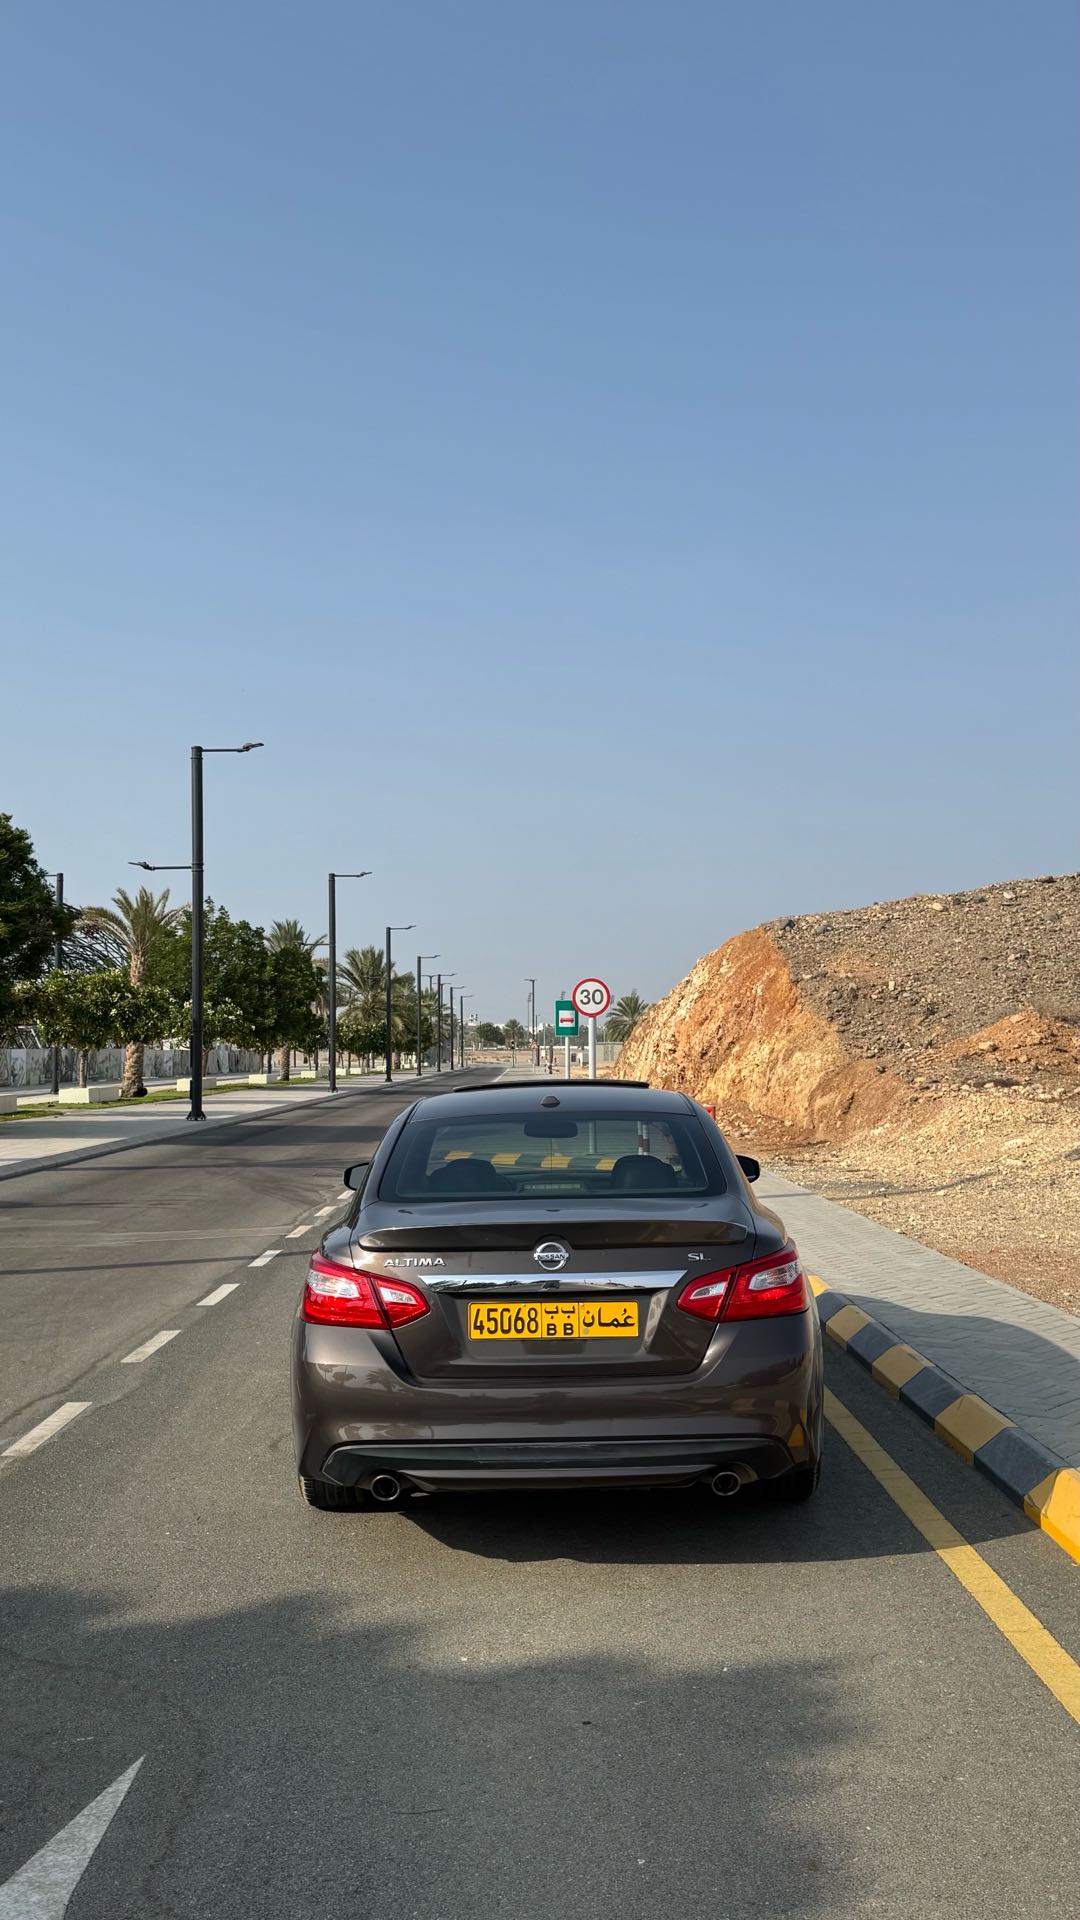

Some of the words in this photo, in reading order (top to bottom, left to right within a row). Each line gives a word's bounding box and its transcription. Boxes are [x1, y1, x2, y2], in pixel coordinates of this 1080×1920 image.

[579, 989, 604, 1005] 30
[383, 1257, 446, 1267] ALTIMA
[687, 1252, 711, 1261] SL
[473, 1307, 539, 1335] 45068
